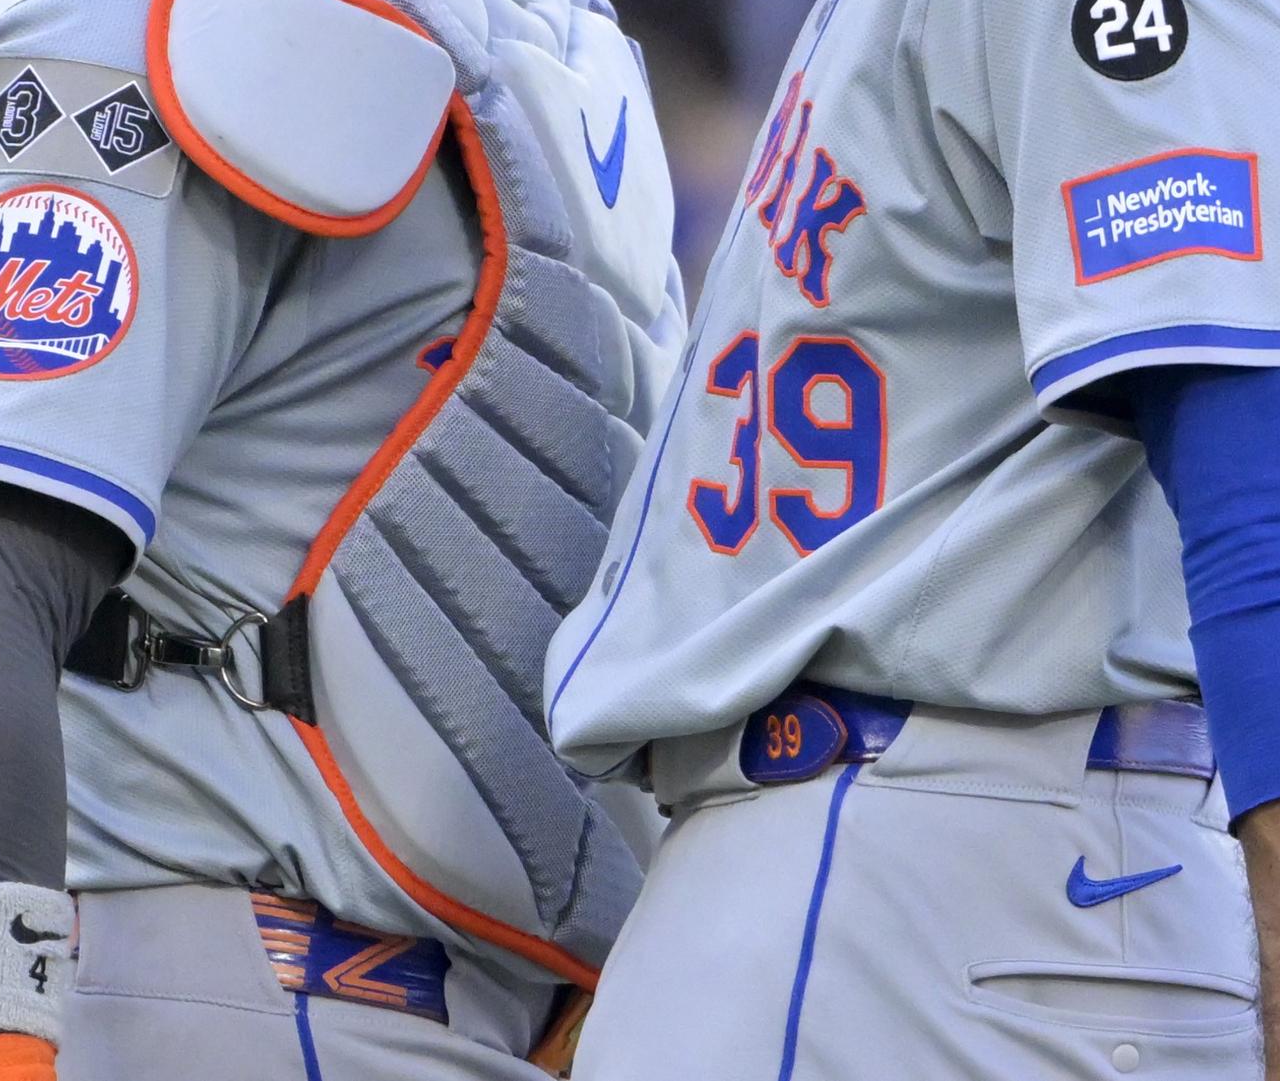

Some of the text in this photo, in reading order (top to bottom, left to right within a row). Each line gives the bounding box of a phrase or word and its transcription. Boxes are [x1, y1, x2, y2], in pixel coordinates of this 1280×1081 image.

[0, 81, 42, 147] 3
[99, 101, 151, 156] 15
[1106, 171, 1218, 217] NewYork-
[1110, 199, 1244, 243] Presbyterian
[685, 328, 888, 559] 39
[766, 713, 803, 760] 39
[28, 955, 49, 995] 4
